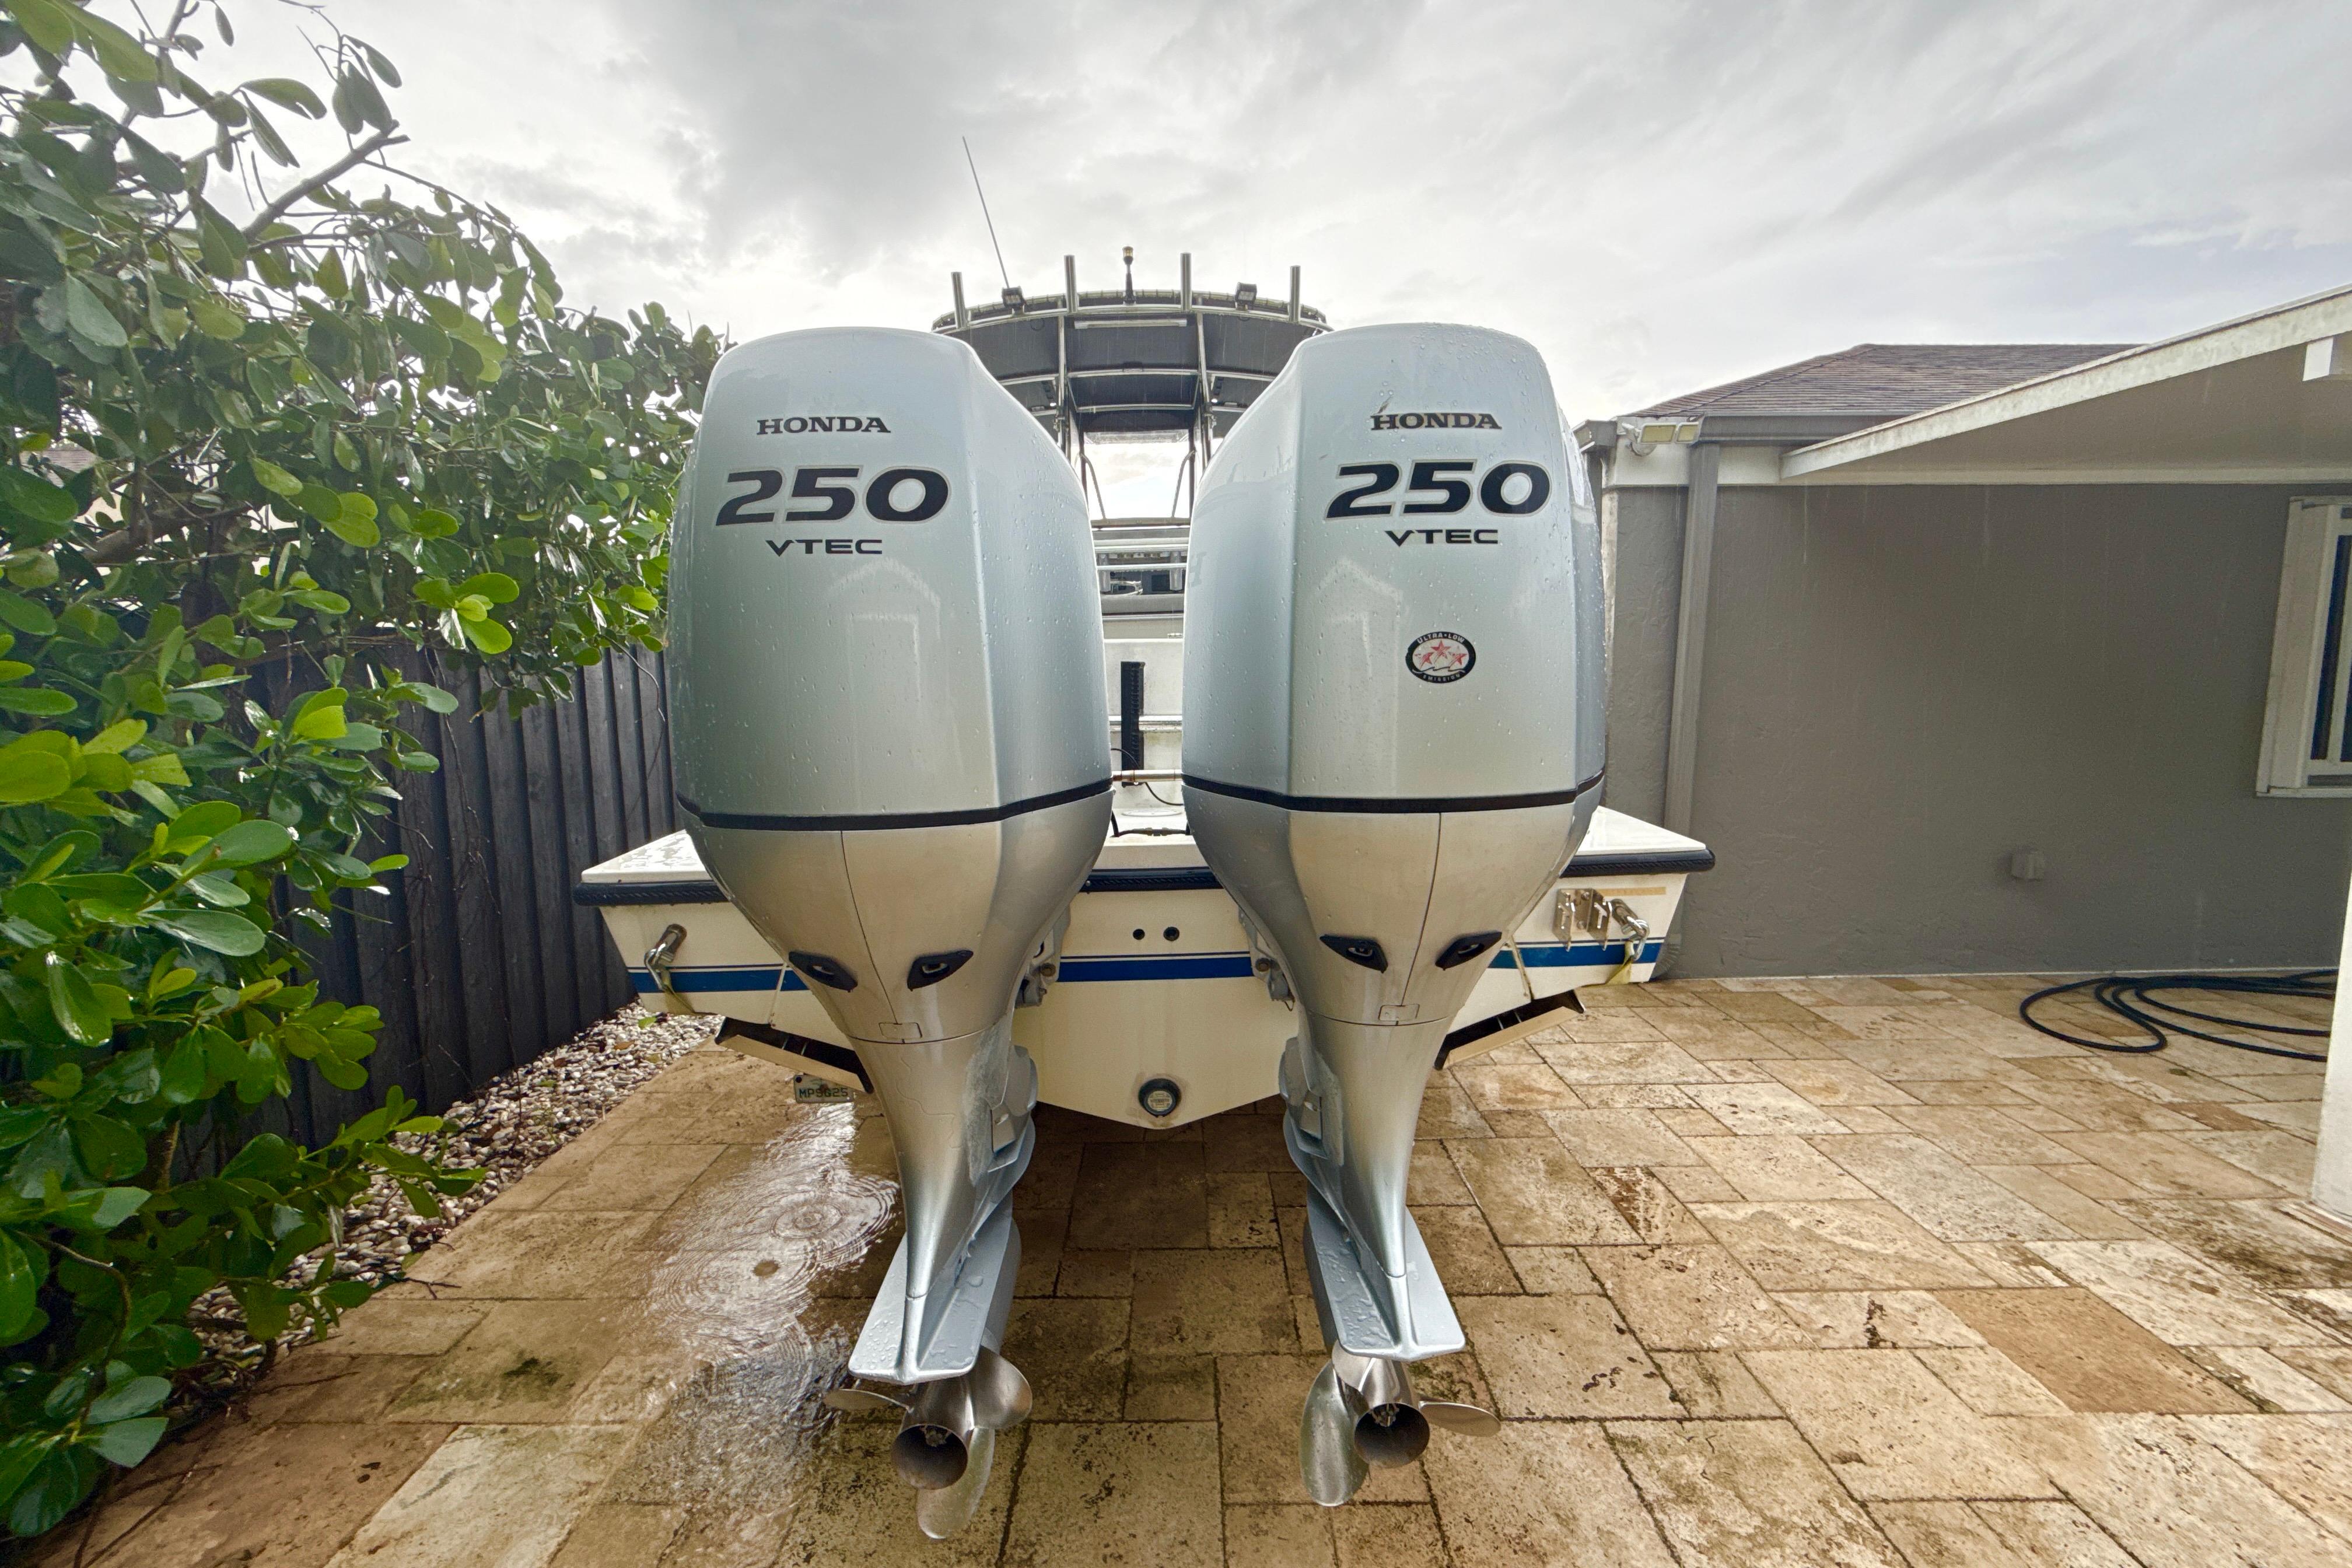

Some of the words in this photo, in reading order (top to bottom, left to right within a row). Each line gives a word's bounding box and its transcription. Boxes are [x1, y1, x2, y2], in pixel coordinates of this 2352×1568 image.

[757, 416, 891, 435] HONDA
[1370, 412, 1502, 431] HONDA
[715, 467, 950, 527] 250
[1325, 460, 1552, 520] 250
[1385, 529, 1498, 547] VTEC
[765, 539, 883, 557] VTEC
[1423, 672, 1461, 682] EMISSION
